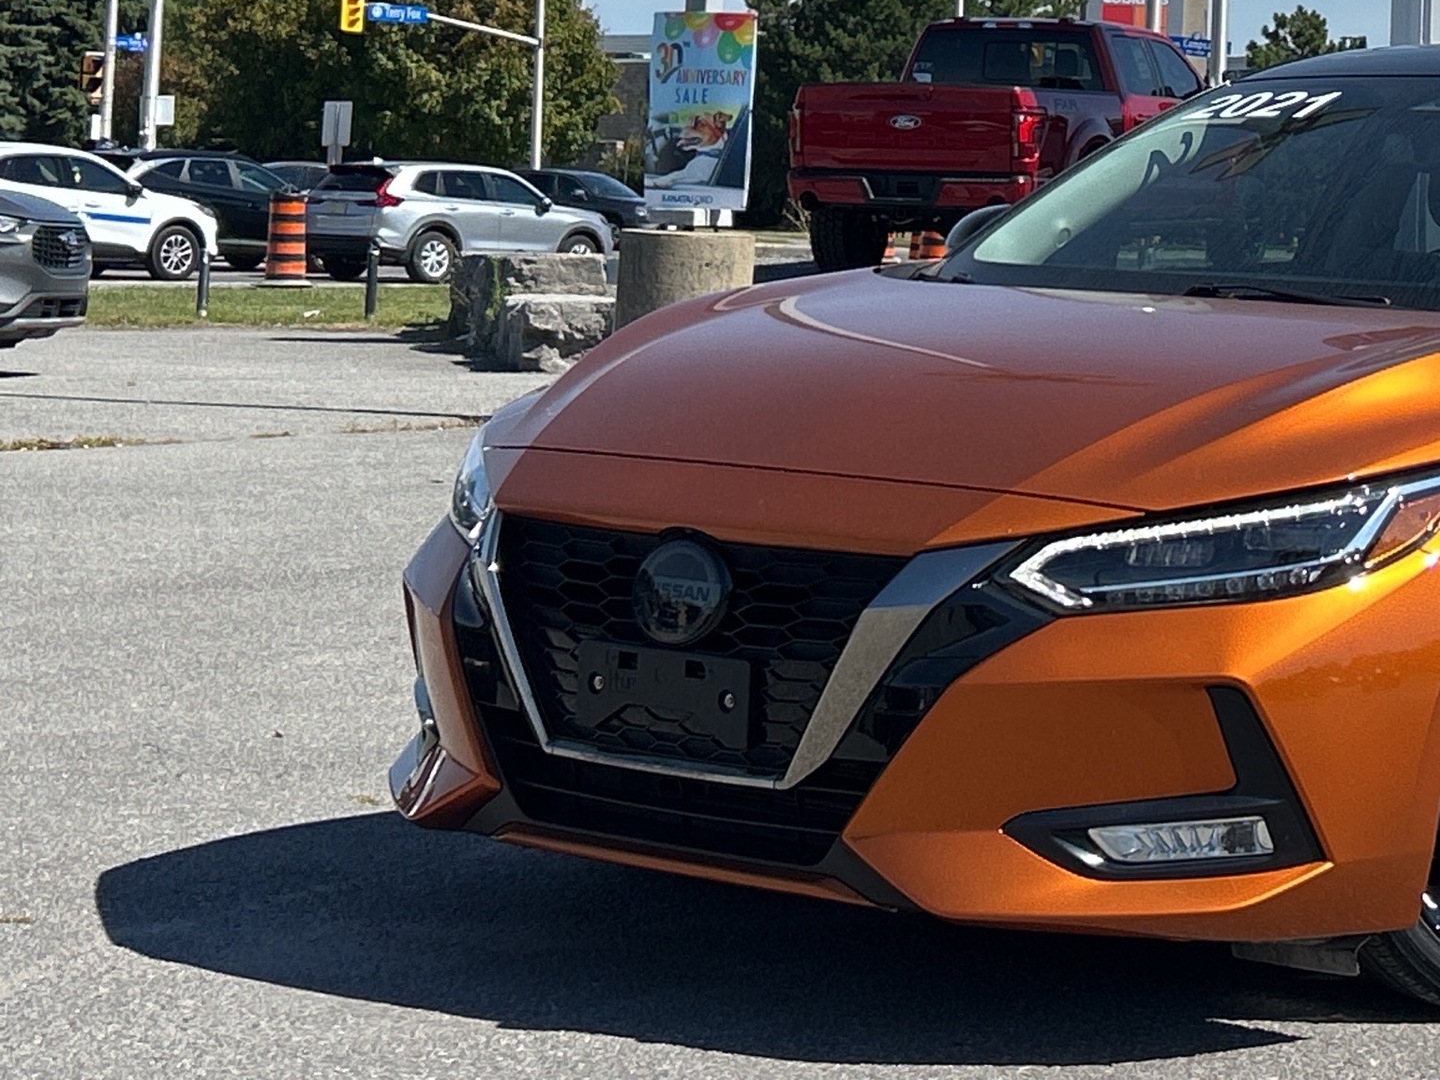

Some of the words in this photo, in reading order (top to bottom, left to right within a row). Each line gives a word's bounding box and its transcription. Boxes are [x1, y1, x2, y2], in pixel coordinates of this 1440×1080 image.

[676, 69, 747, 85] ANNIVERSARY
[675, 88, 708, 104] SALE
[1181, 92, 1343, 119] 2021
